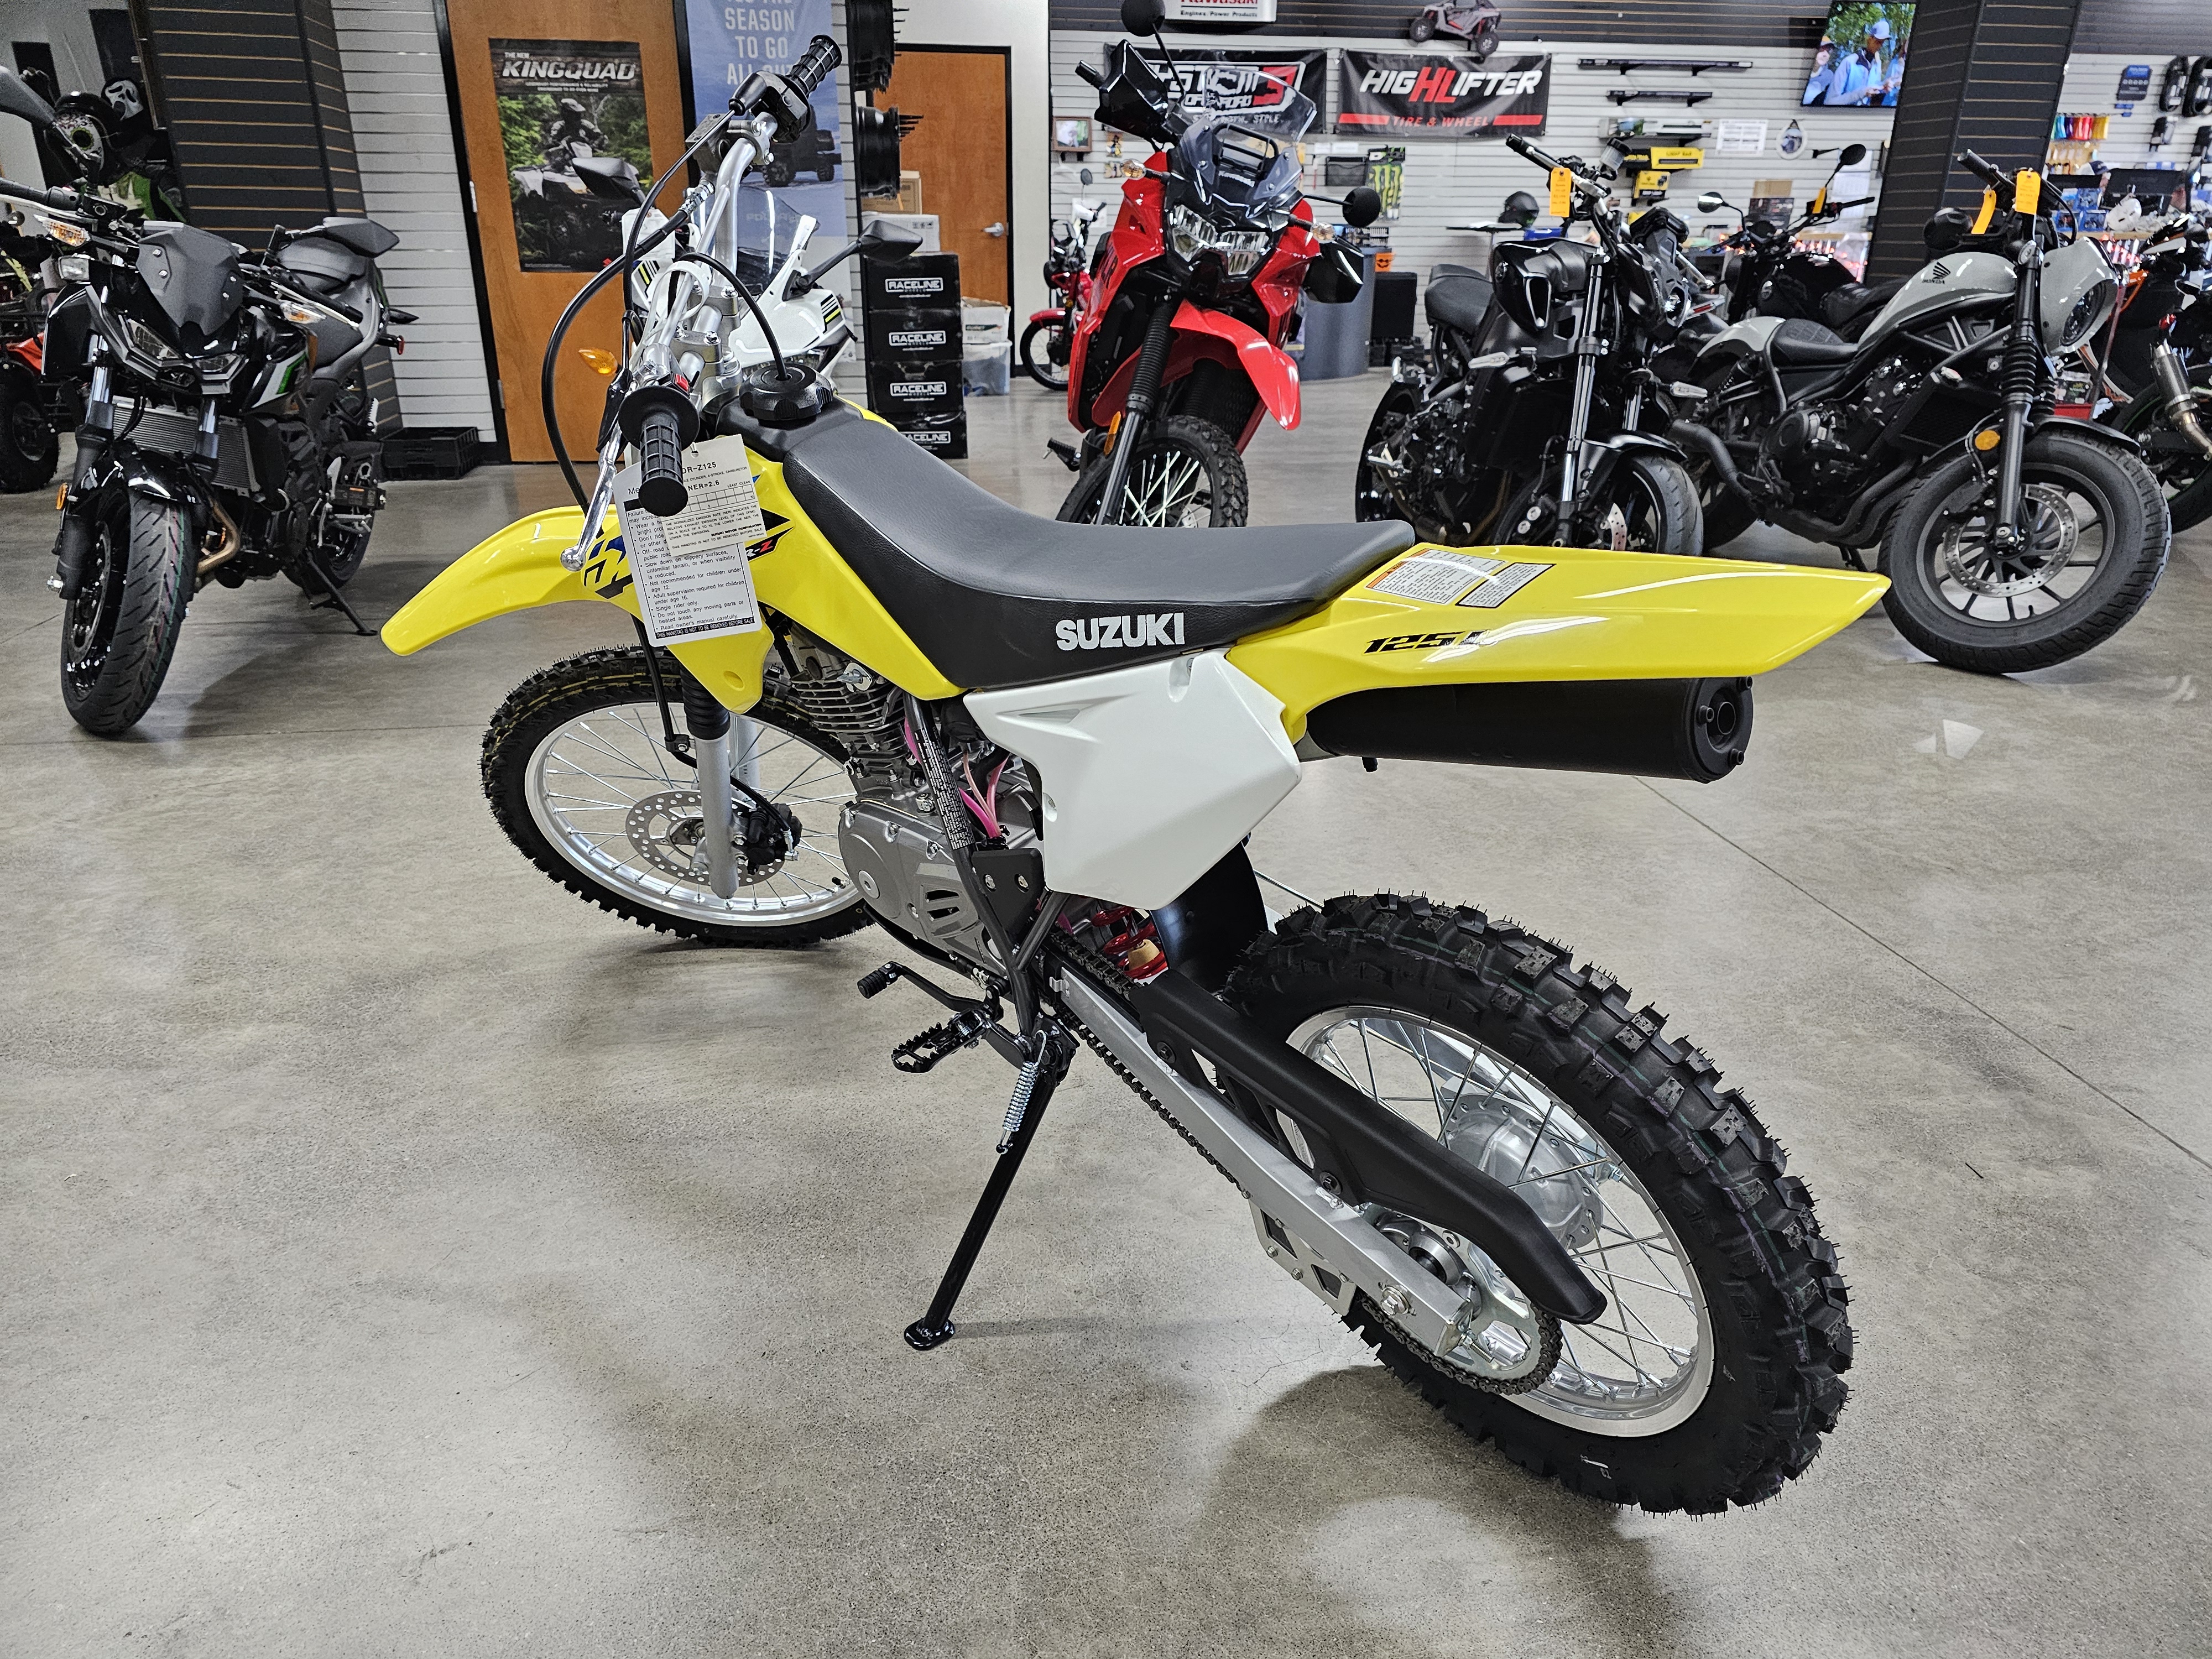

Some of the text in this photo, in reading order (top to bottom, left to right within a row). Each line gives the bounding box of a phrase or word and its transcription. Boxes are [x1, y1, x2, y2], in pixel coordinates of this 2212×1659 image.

[724, 7, 795, 32] SEASON
[734, 35, 788, 59] TO GO
[502, 61, 635, 80] KINGQUAD
[1359, 66, 1543, 103] HIGHLIFTER
[1392, 116, 1489, 127] TIRE & WHEEL
[889, 280, 940, 289] RACELINE
[892, 333, 943, 343] RACELINE
[894, 384, 943, 393] RACELINE
[687, 480, 719, 491] NER=2.6
[641, 546, 664, 555] Off-road
[661, 574, 695, 584] recommended
[1056, 612, 1185, 651] SUZUKI
